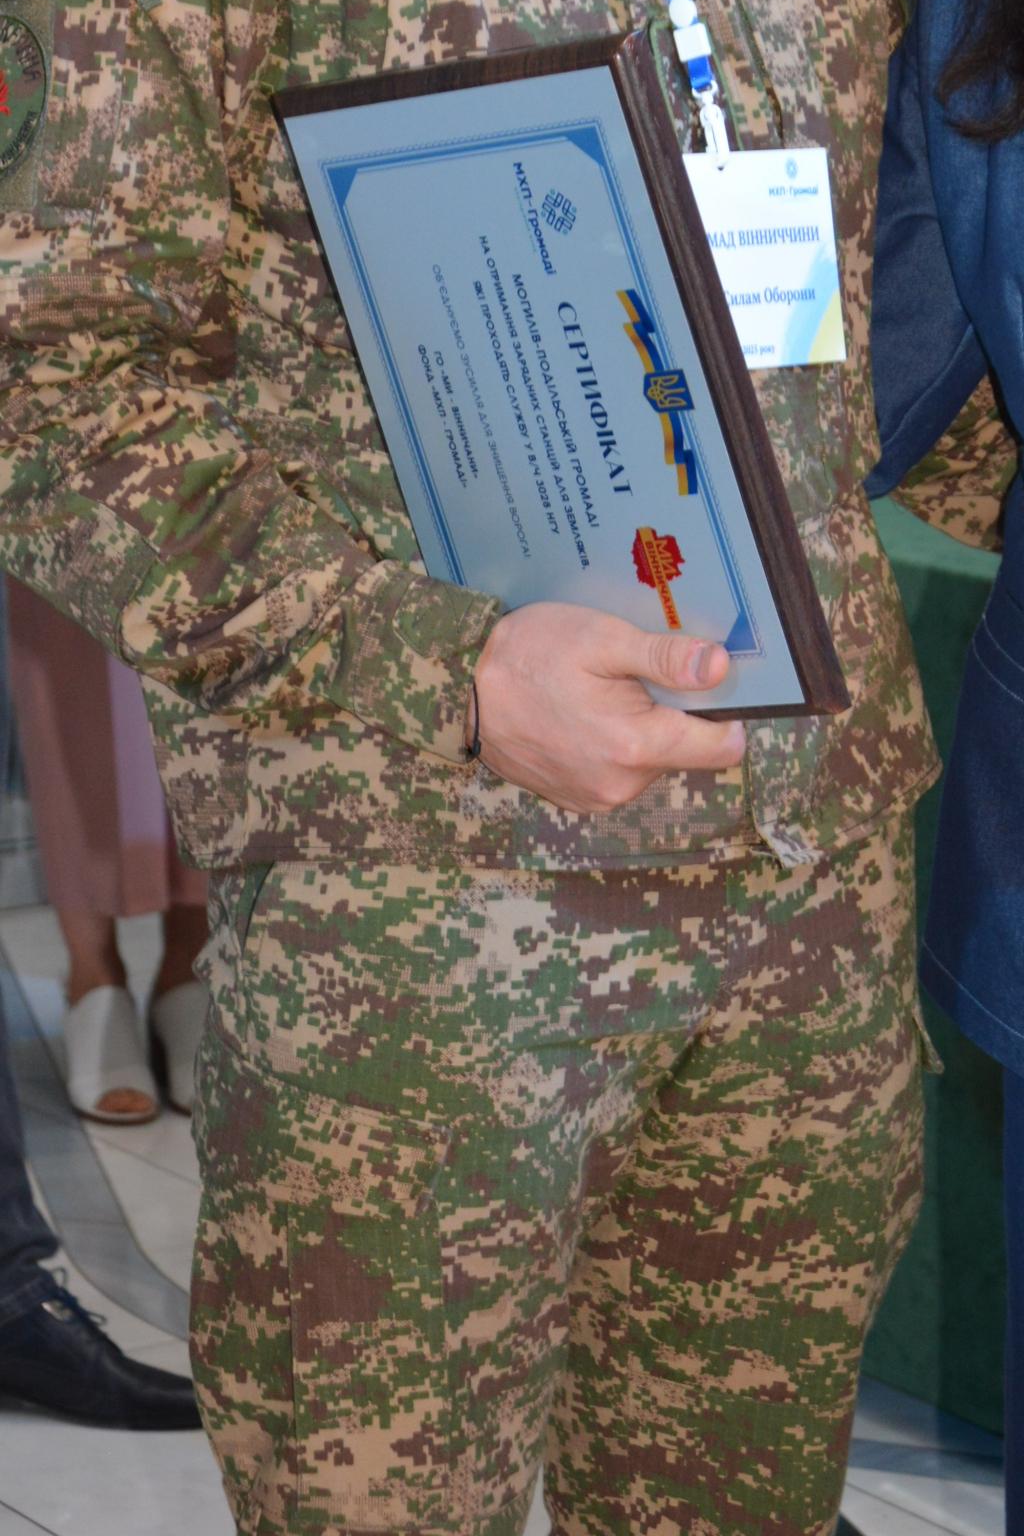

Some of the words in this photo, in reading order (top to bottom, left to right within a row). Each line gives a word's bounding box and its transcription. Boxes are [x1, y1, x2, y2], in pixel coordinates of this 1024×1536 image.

[477, 235, 493, 254] НА
[706, 231, 736, 250] МАД
[738, 226, 820, 246] ВІННИЧЧИНИ
[471, 279, 486, 301] ЯКІ
[484, 256, 519, 338] ОТРИМАННЯ
[764, 286, 816, 305] Оборони
[415, 342, 437, 383] ФОНД
[432, 349, 445, 367] ГО
[478, 303, 512, 382] ПРОХОДЯТЬ
[510, 340, 541, 411] ЗАРЯДНИХ
[554, 300, 634, 499] СЕРТИФІКАТ
[504, 383, 530, 439] СЛУЖБУ
[509, 272, 578, 454] МОГИЛІВ-ПОДІЛЬСЬКІЙ
[567, 457, 601, 529] ГРОМАДІ
[458, 352, 485, 410] ЗУСИЛЛЯ
[477, 410, 494, 438] ДЛЯ
[486, 439, 515, 505] ЗНИЩЕННЯ
[533, 413, 561, 471] СТАНЦІЙ
[552, 473, 570, 503] ДЛЯ
[544, 510, 560, 535] НГУ
[653, 538, 677, 575] МИ
[643, 540, 678, 627] ВІННИЧАНИ
